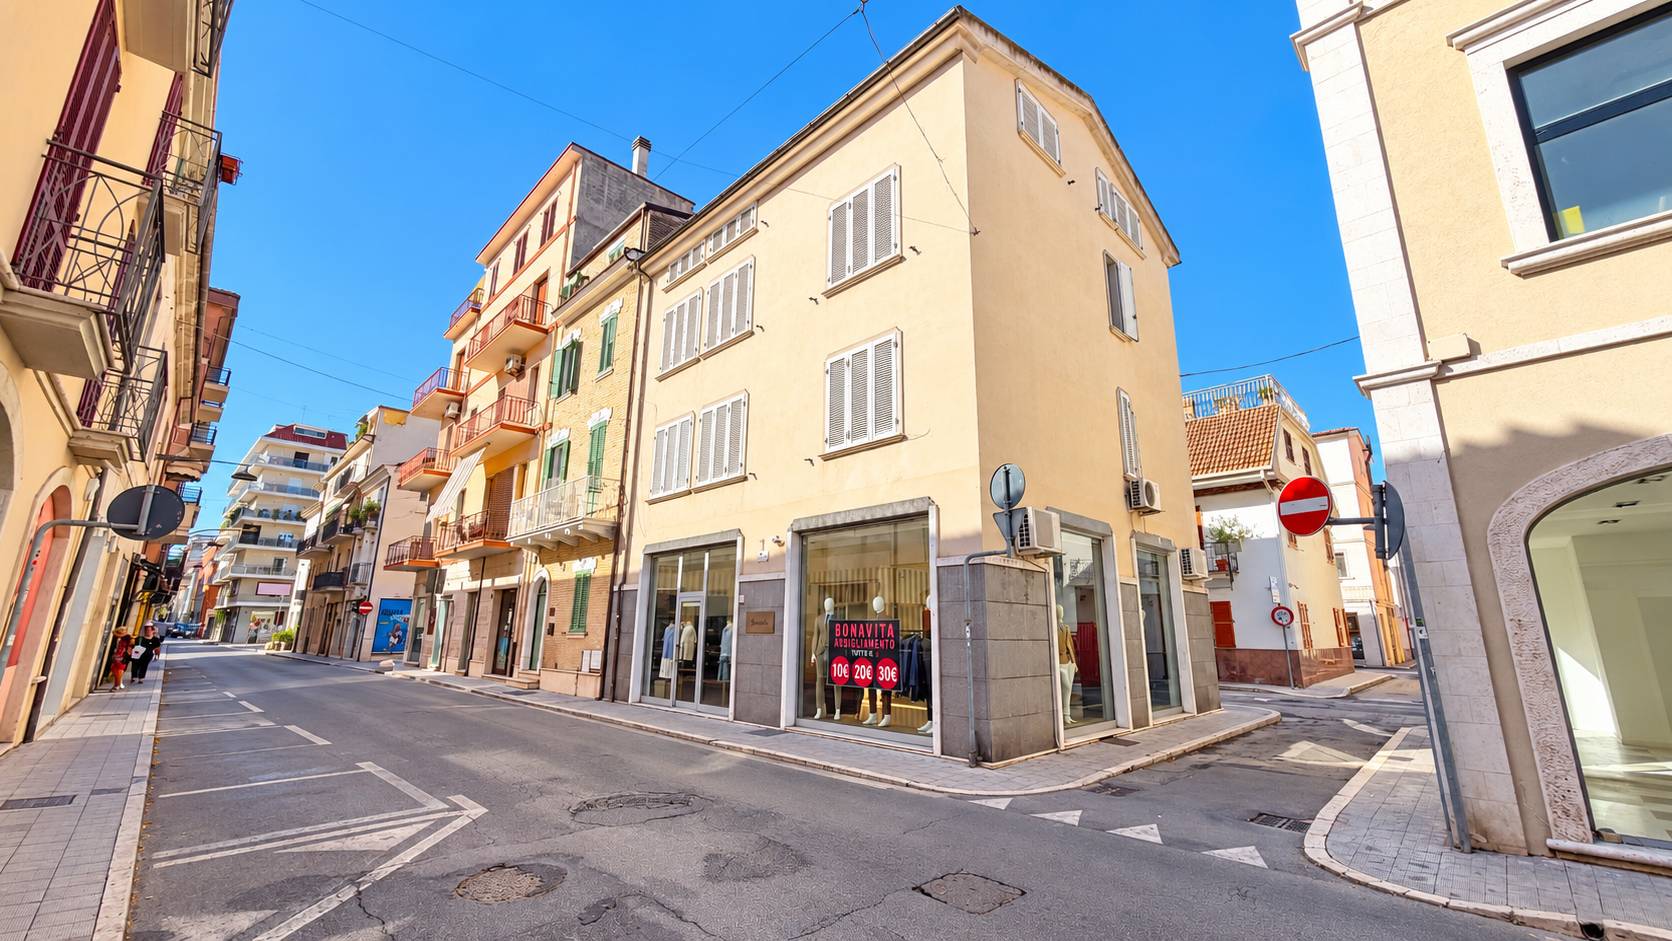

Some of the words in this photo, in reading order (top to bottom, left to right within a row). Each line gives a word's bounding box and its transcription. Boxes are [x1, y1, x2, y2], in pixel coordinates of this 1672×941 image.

[835, 623, 895, 638] BONAVITA
[832, 663, 849, 678] 10€
[854, 664, 873, 680] 20€
[878, 666, 898, 682] 30€
